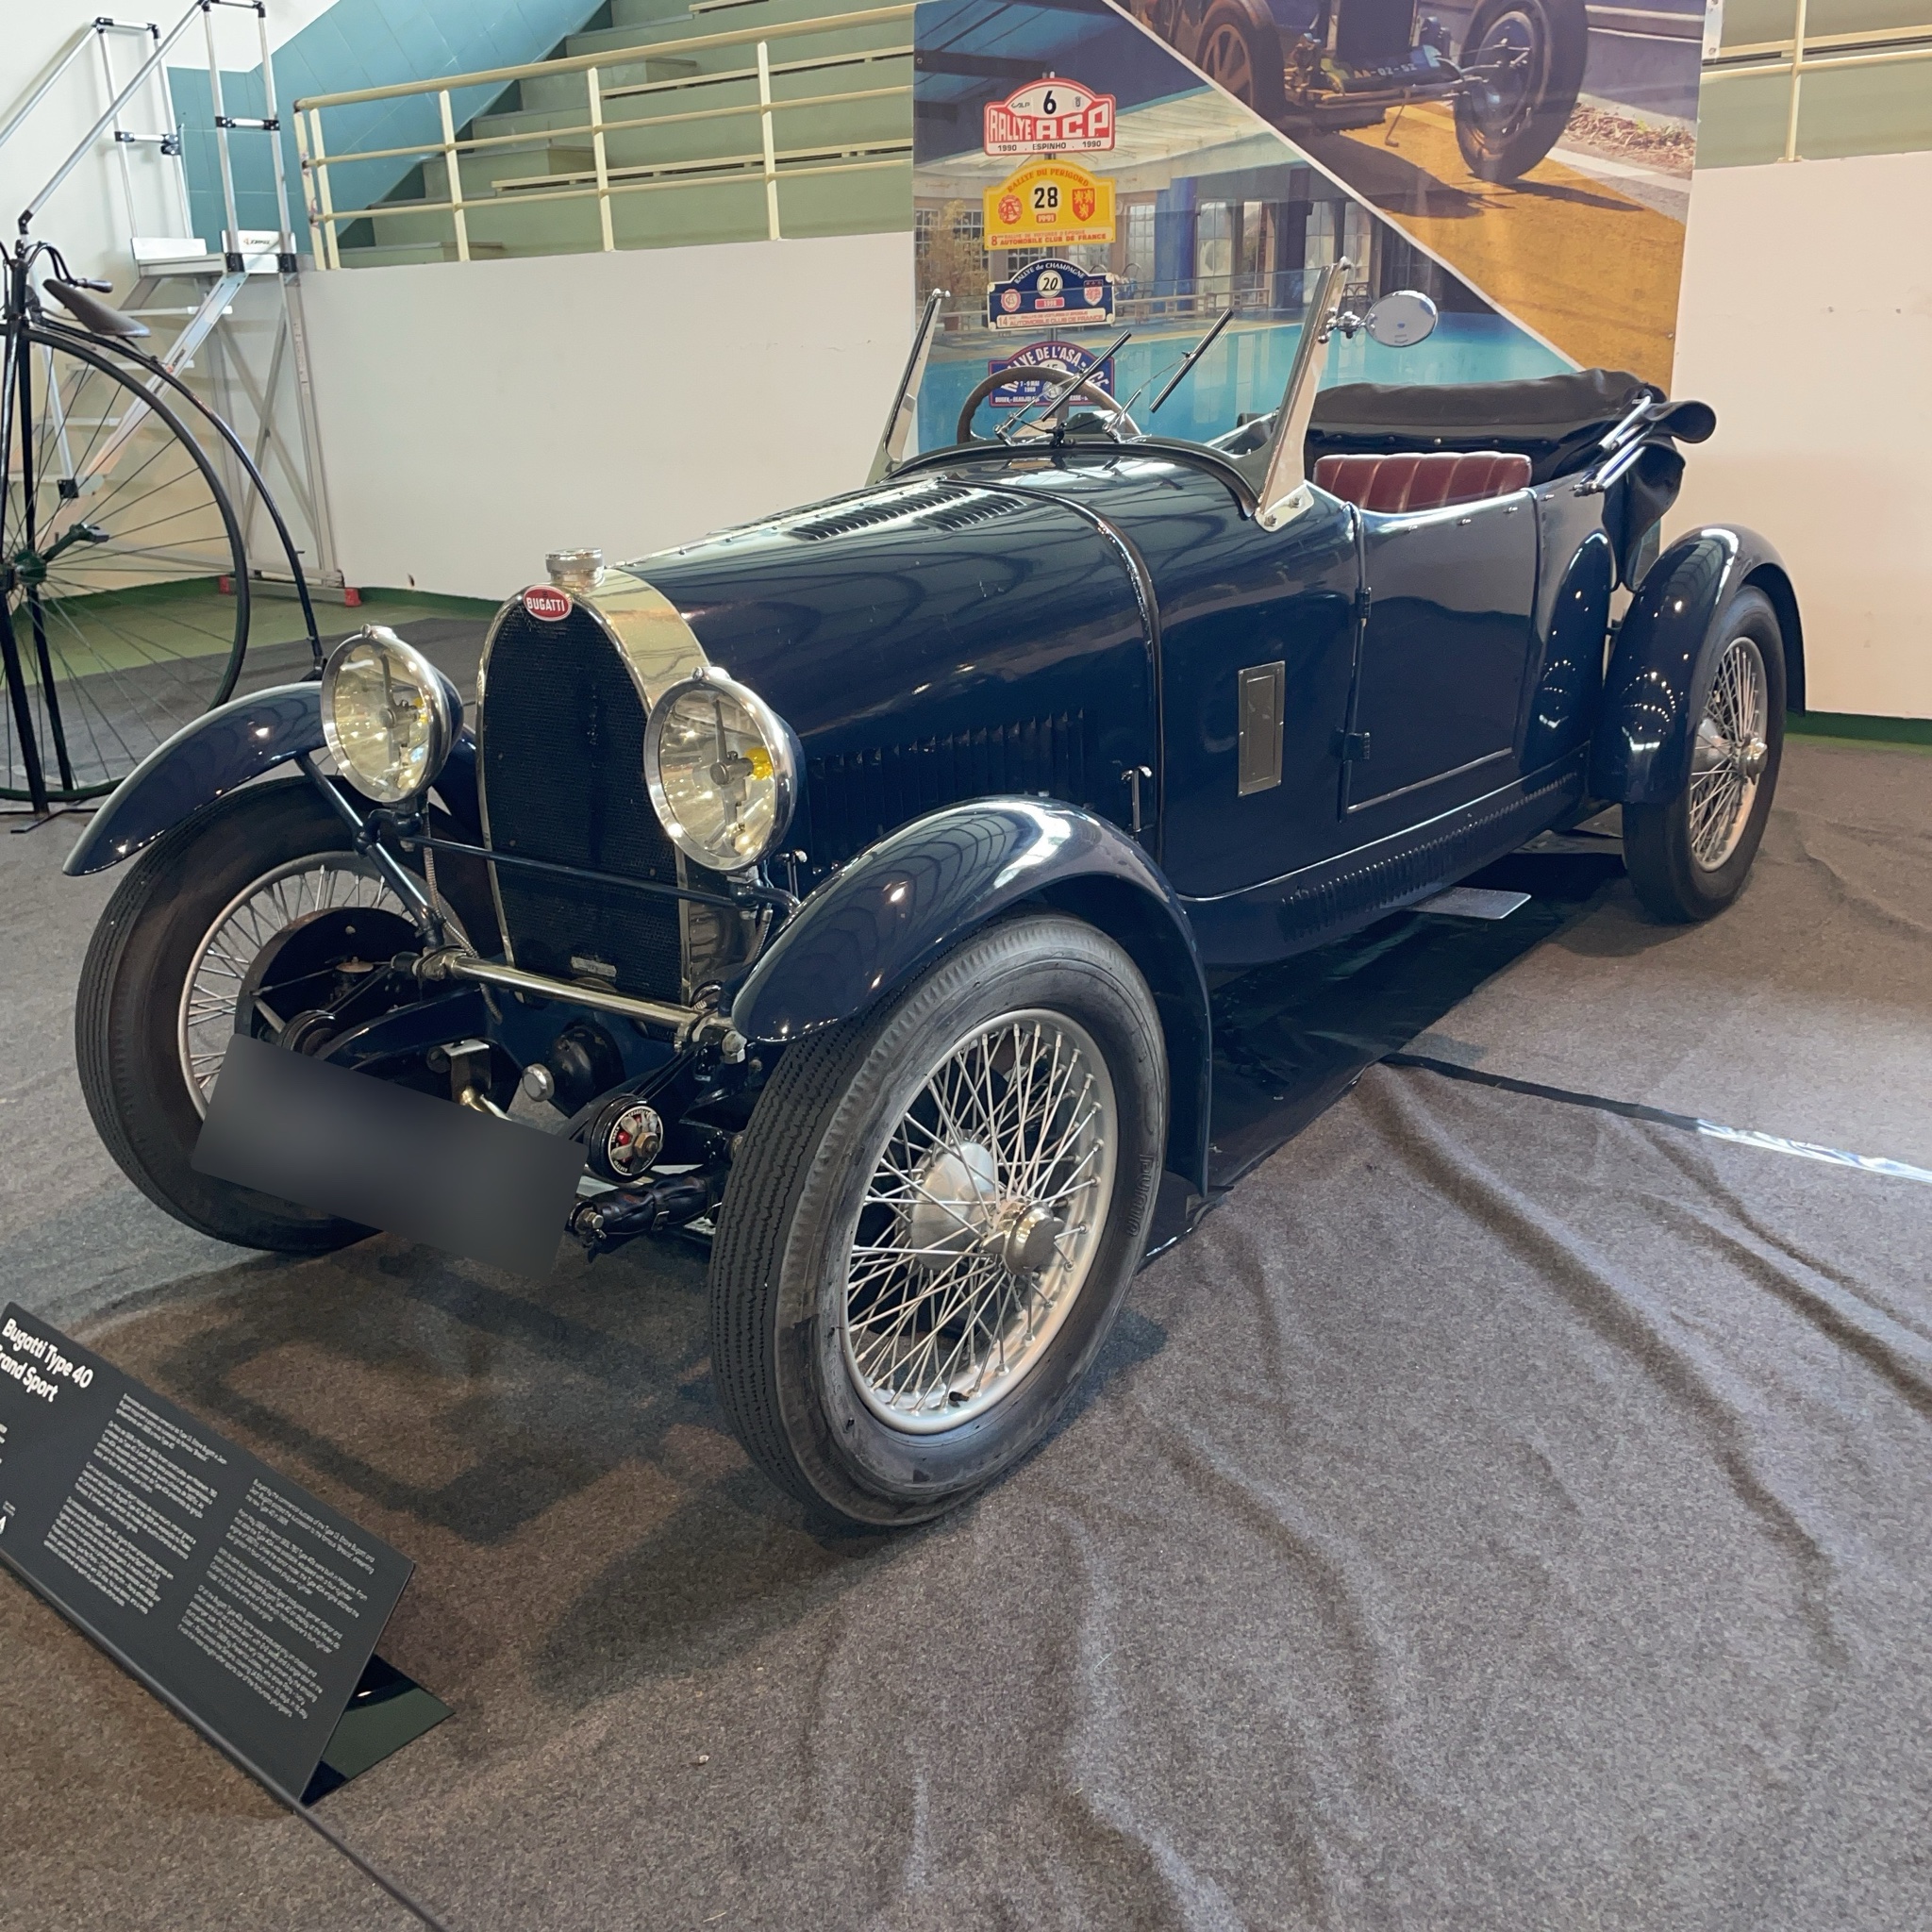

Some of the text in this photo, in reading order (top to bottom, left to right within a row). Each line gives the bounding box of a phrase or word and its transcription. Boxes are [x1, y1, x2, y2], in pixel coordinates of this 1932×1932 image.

[1043, 90, 1057, 115] 6
[991, 108, 1031, 142] RALLYE
[1033, 142, 1067, 151] ESPINHO
[1082, 140, 1102, 148] 1990
[1008, 172, 1034, 192] RALLYE
[1037, 168, 1048, 176] DU
[1034, 187, 1058, 208] 28
[1045, 262, 1086, 279] CHAMPAGNE
[1042, 277, 1058, 291] 20
[1036, 346, 1049, 361] DE
[526, 597, 565, 612] BUGATTI
[2, 1318, 93, 1389] Bugatti Type 40
[0, 1344, 58, 1403] rand Sport
